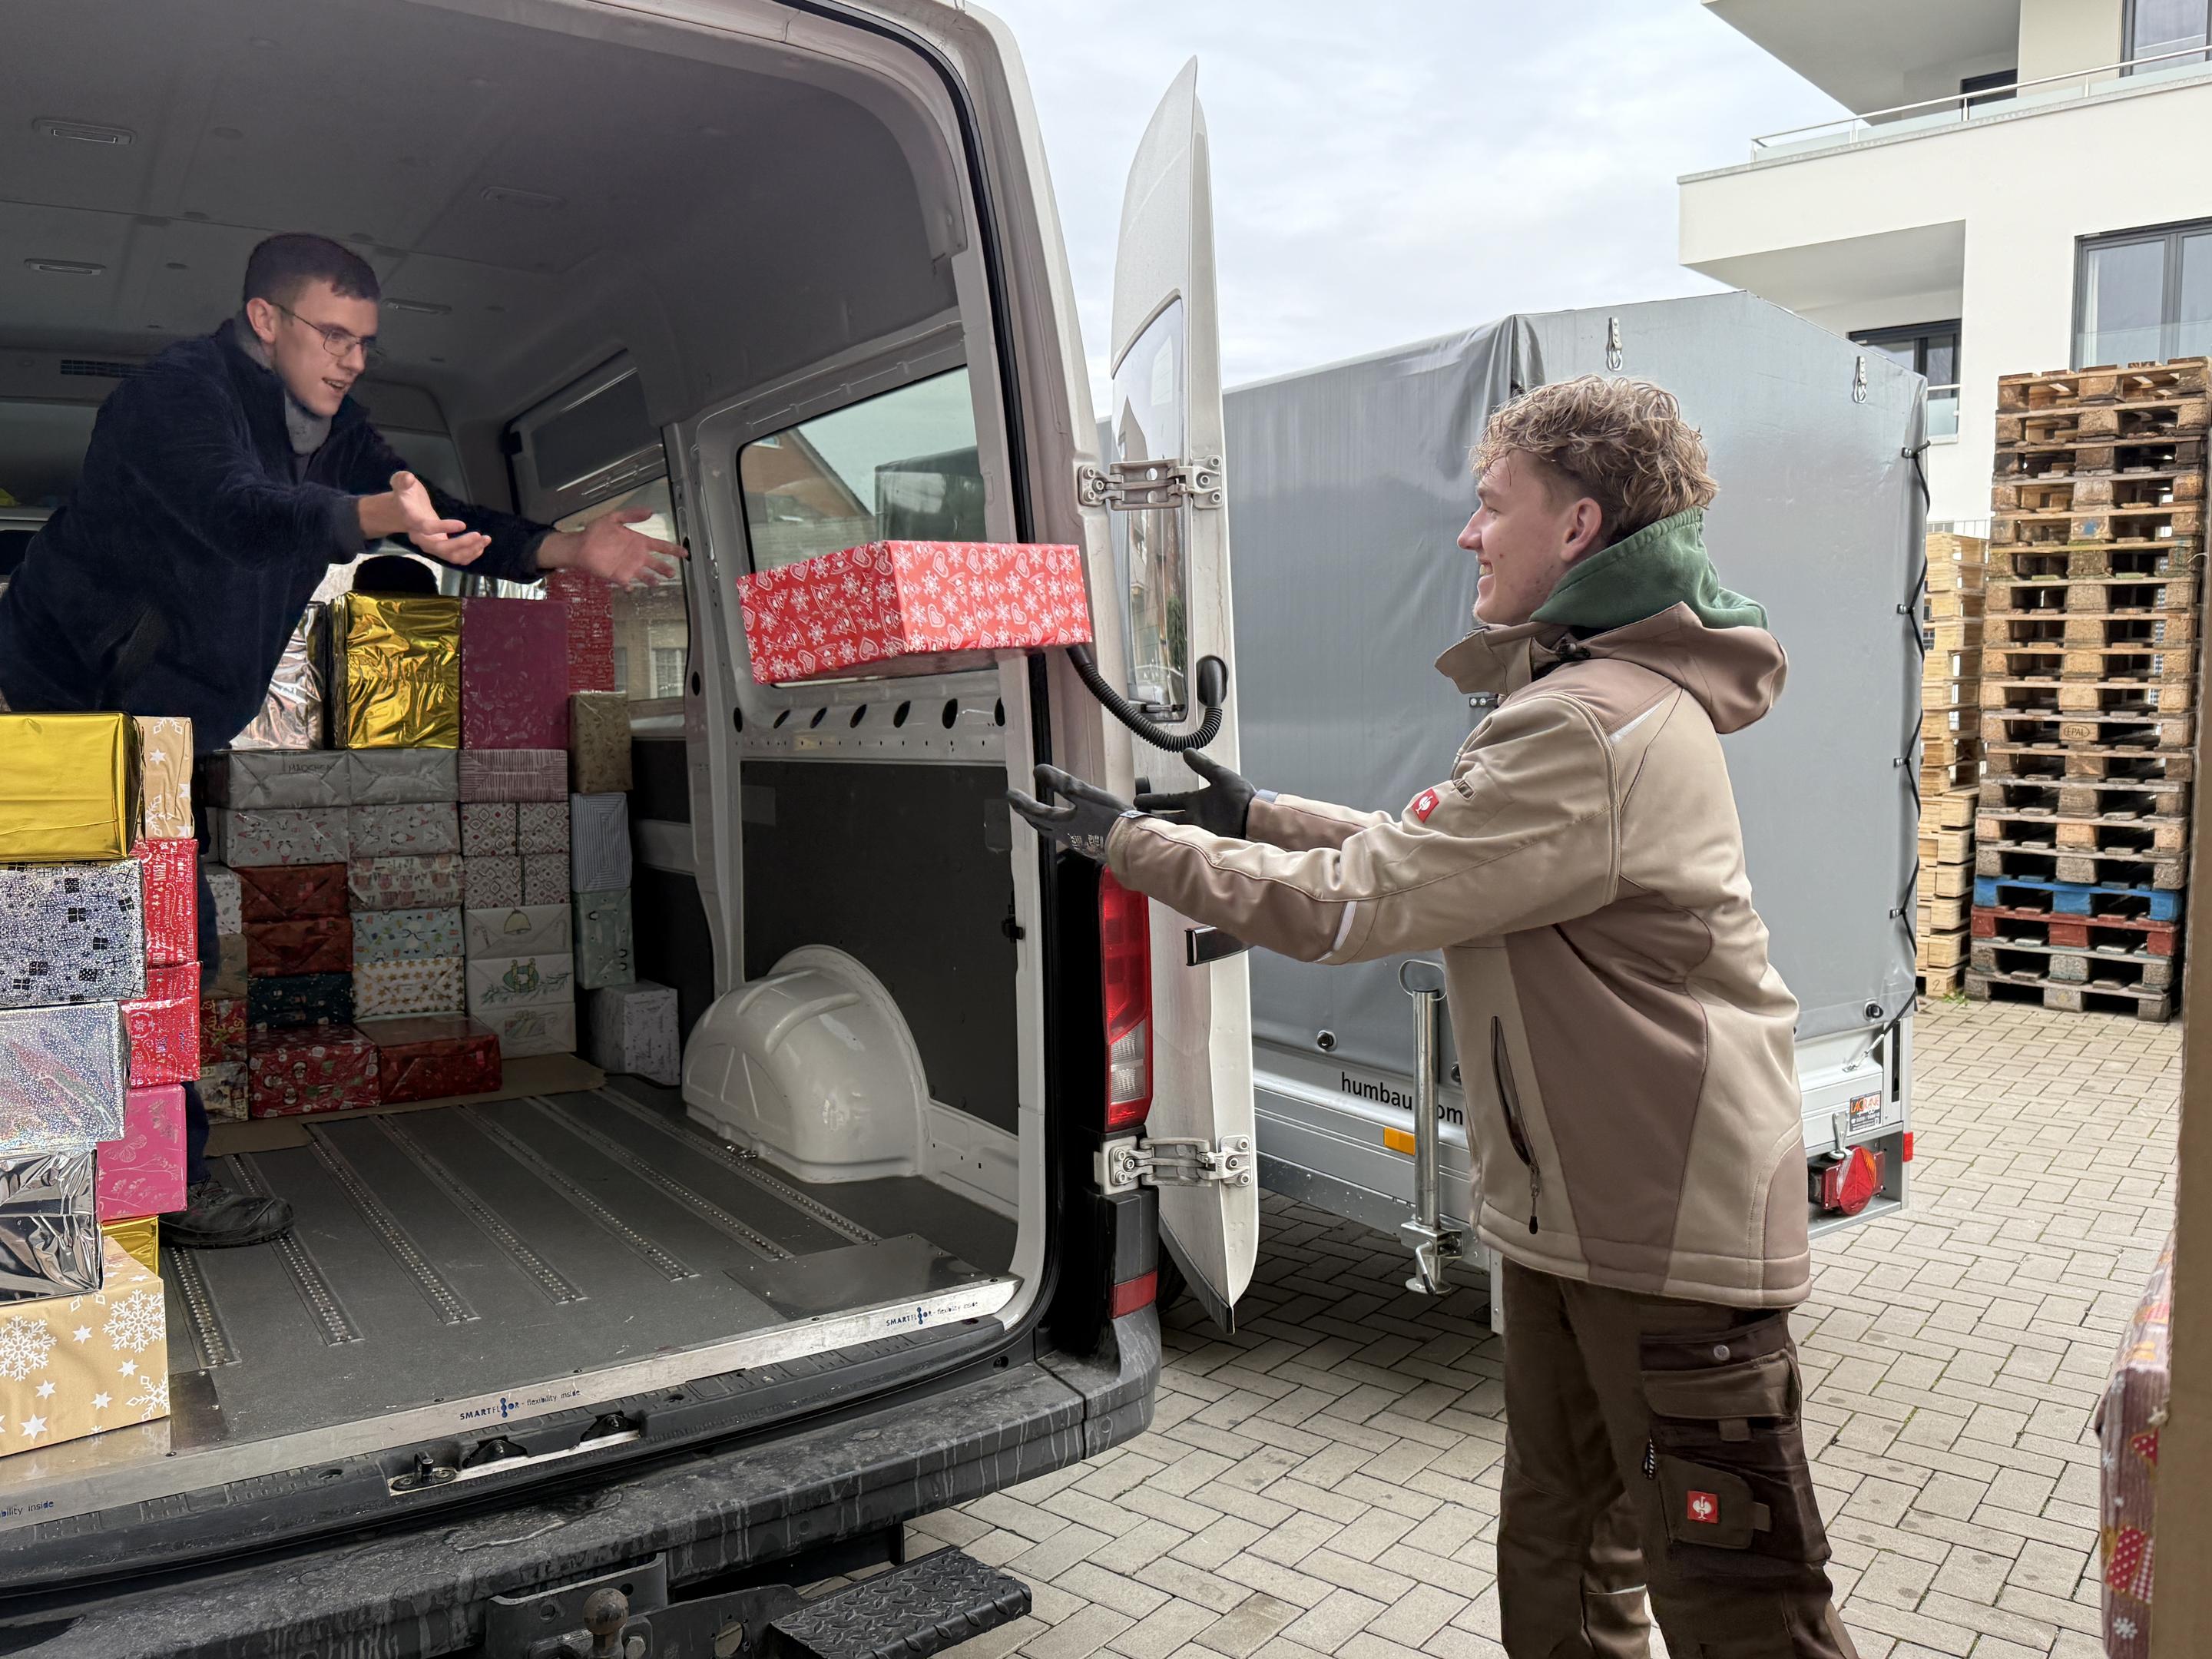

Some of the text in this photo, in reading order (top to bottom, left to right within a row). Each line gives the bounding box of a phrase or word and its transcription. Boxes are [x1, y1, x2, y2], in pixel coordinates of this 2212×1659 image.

[176, 857, 187, 882] Happy
[527, 1393, 557, 1406] flexibility
[28, 1501, 54, 1512] inside
